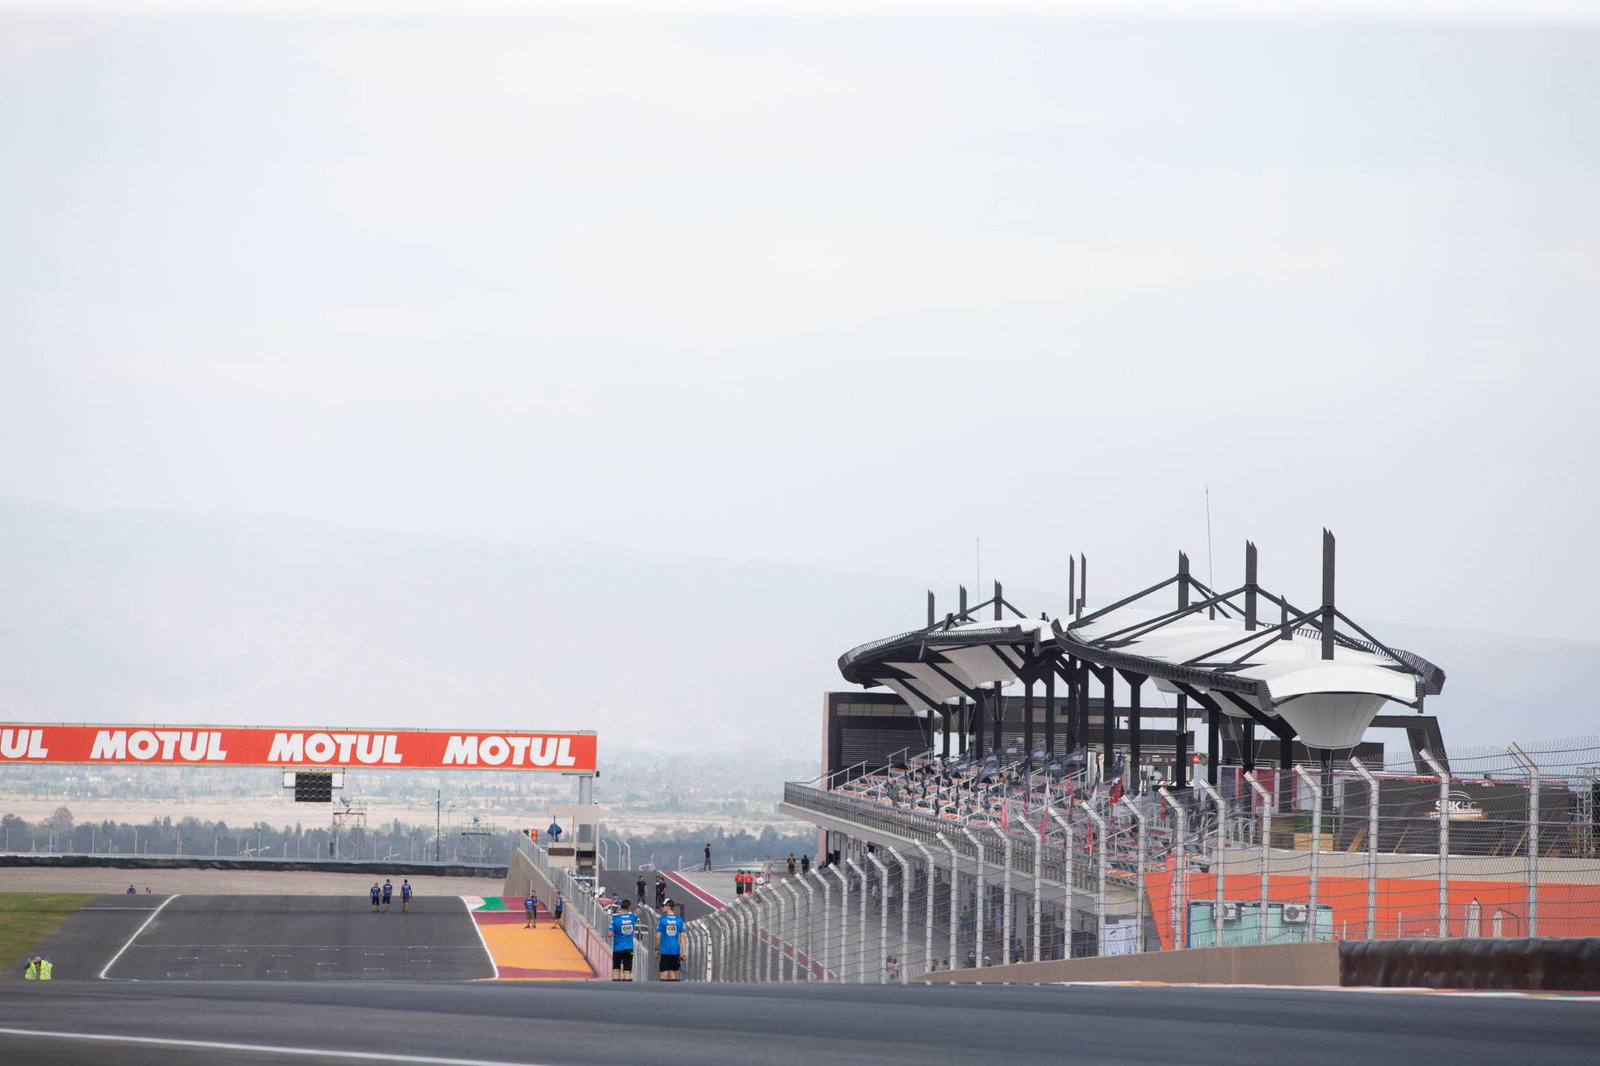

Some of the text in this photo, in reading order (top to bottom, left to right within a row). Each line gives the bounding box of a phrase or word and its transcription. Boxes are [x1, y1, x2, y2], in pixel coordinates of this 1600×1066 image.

[0, 729, 49, 758] UL
[89, 730, 228, 761] MOTUL
[267, 733, 403, 763] MOTUL
[441, 735, 577, 766] MOTUL
